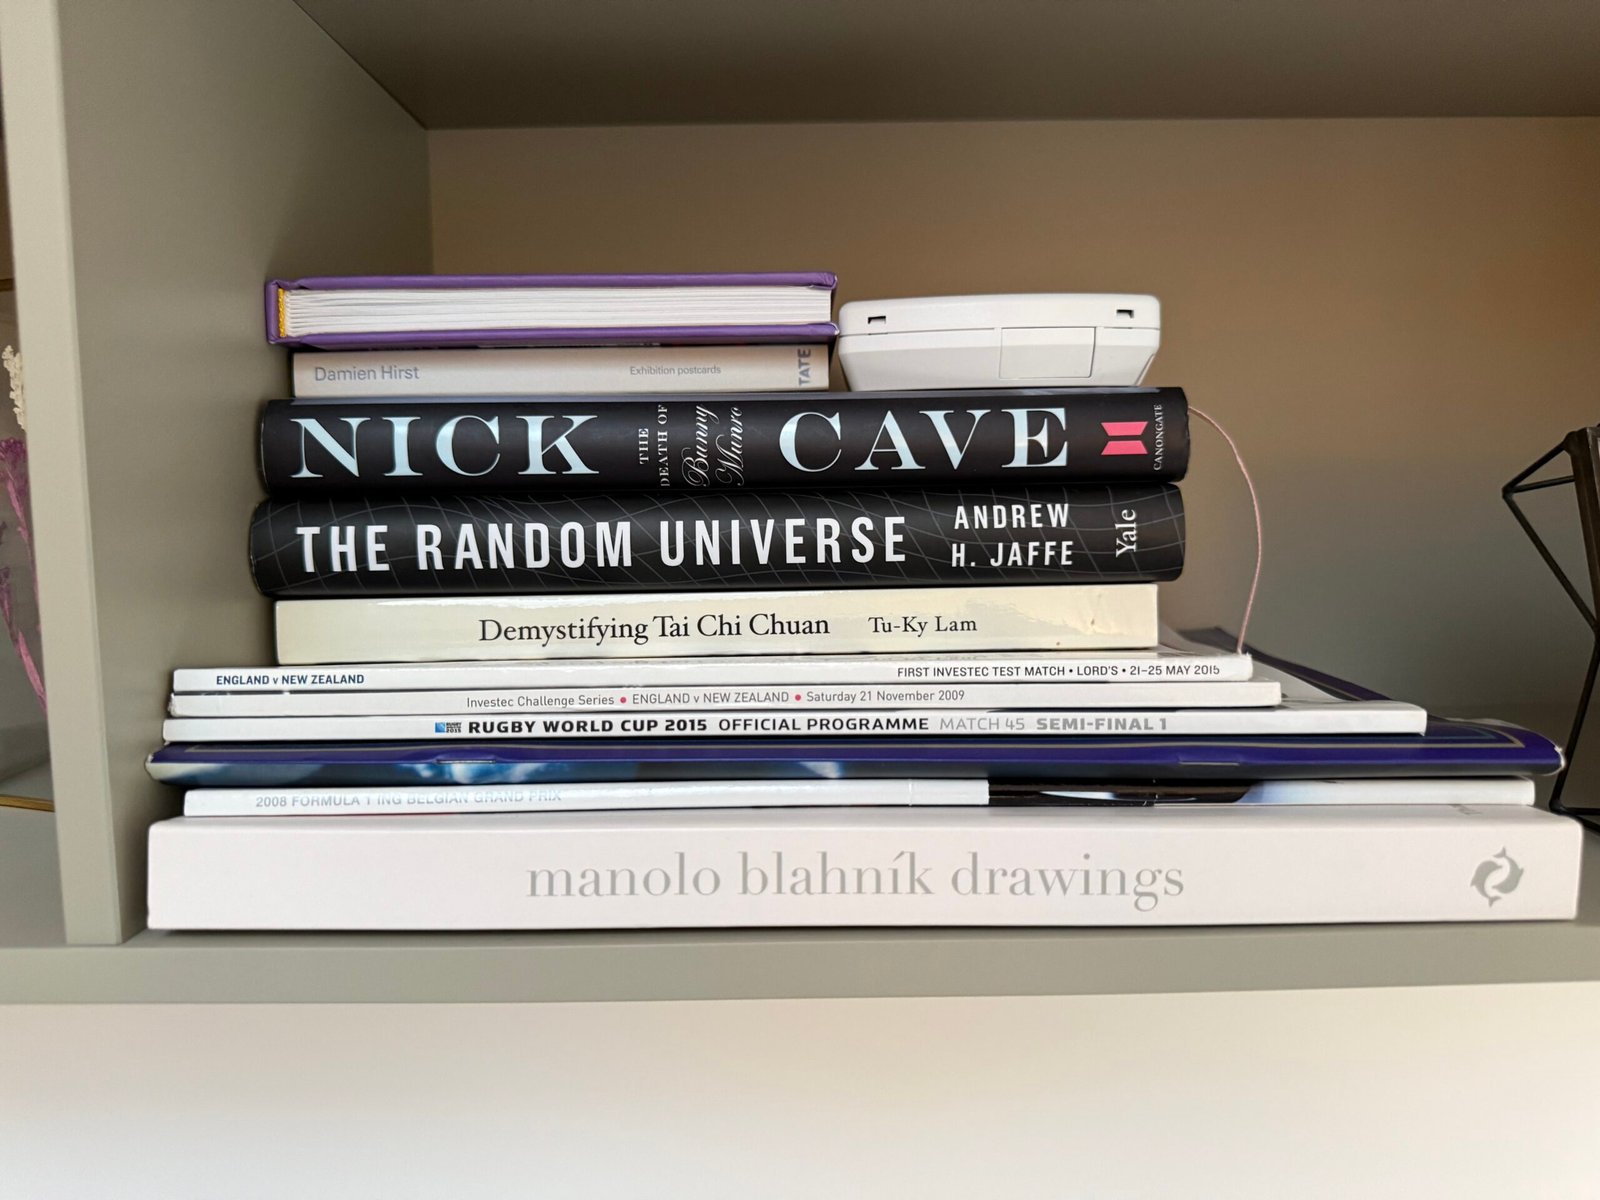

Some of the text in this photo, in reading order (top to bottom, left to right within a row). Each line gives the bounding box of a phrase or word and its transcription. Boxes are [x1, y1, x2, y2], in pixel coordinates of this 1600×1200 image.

[314, 365, 419, 381] Damien Hirst
[630, 364, 721, 377] Exhibition postcards
[798, 348, 811, 386] TATE
[290, 407, 1069, 478] NICK CAVE
[639, 428, 649, 464] THE
[658, 404, 670, 487] DEATH OF
[681, 404, 719, 487] Bunny
[715, 407, 744, 486] Munro
[1153, 404, 1164, 471] CANONGATE
[953, 503, 1070, 530] ANDREW
[296, 516, 906, 573] THE RANDOM UNIVERSE
[1115, 509, 1137, 558] Yale
[951, 540, 1074, 567] H. JAFFE
[480, 613, 830, 646] Demystifying Tai Chi Chuan
[868, 616, 978, 637] Tu-Ky Lam
[216, 674, 269, 685] ENGLAND
[281, 675, 308, 685] NEW
[311, 674, 364, 685] ZEALAND
[897, 666, 929, 678] FIRST
[933, 666, 989, 677] INVESTEC
[992, 666, 1022, 677] TEST
[1025, 665, 1065, 676] MATCH
[1077, 665, 1118, 676] LORD'S
[1166, 665, 1190, 675] MAY
[1194, 665, 1220, 675] 2015
[467, 689, 965, 709] Investec Challenge Series ENGLAND v NEW ZEALAND Saturday 21 November 2009
[469, 717, 1167, 733] RUGBY WORLD CUP 2015 OFFICIAL PROGRAMME MATCH 45 SEMI-FINAL 1
[256, 796, 287, 807] 2008
[291, 794, 360, 807] FORMULA
[377, 793, 402, 805] ING
[406, 791, 470, 805] BELGIAN
[473, 790, 523, 804] GRAND
[528, 790, 563, 802] PRIX
[527, 851, 1184, 912] manolo blahník drawings
